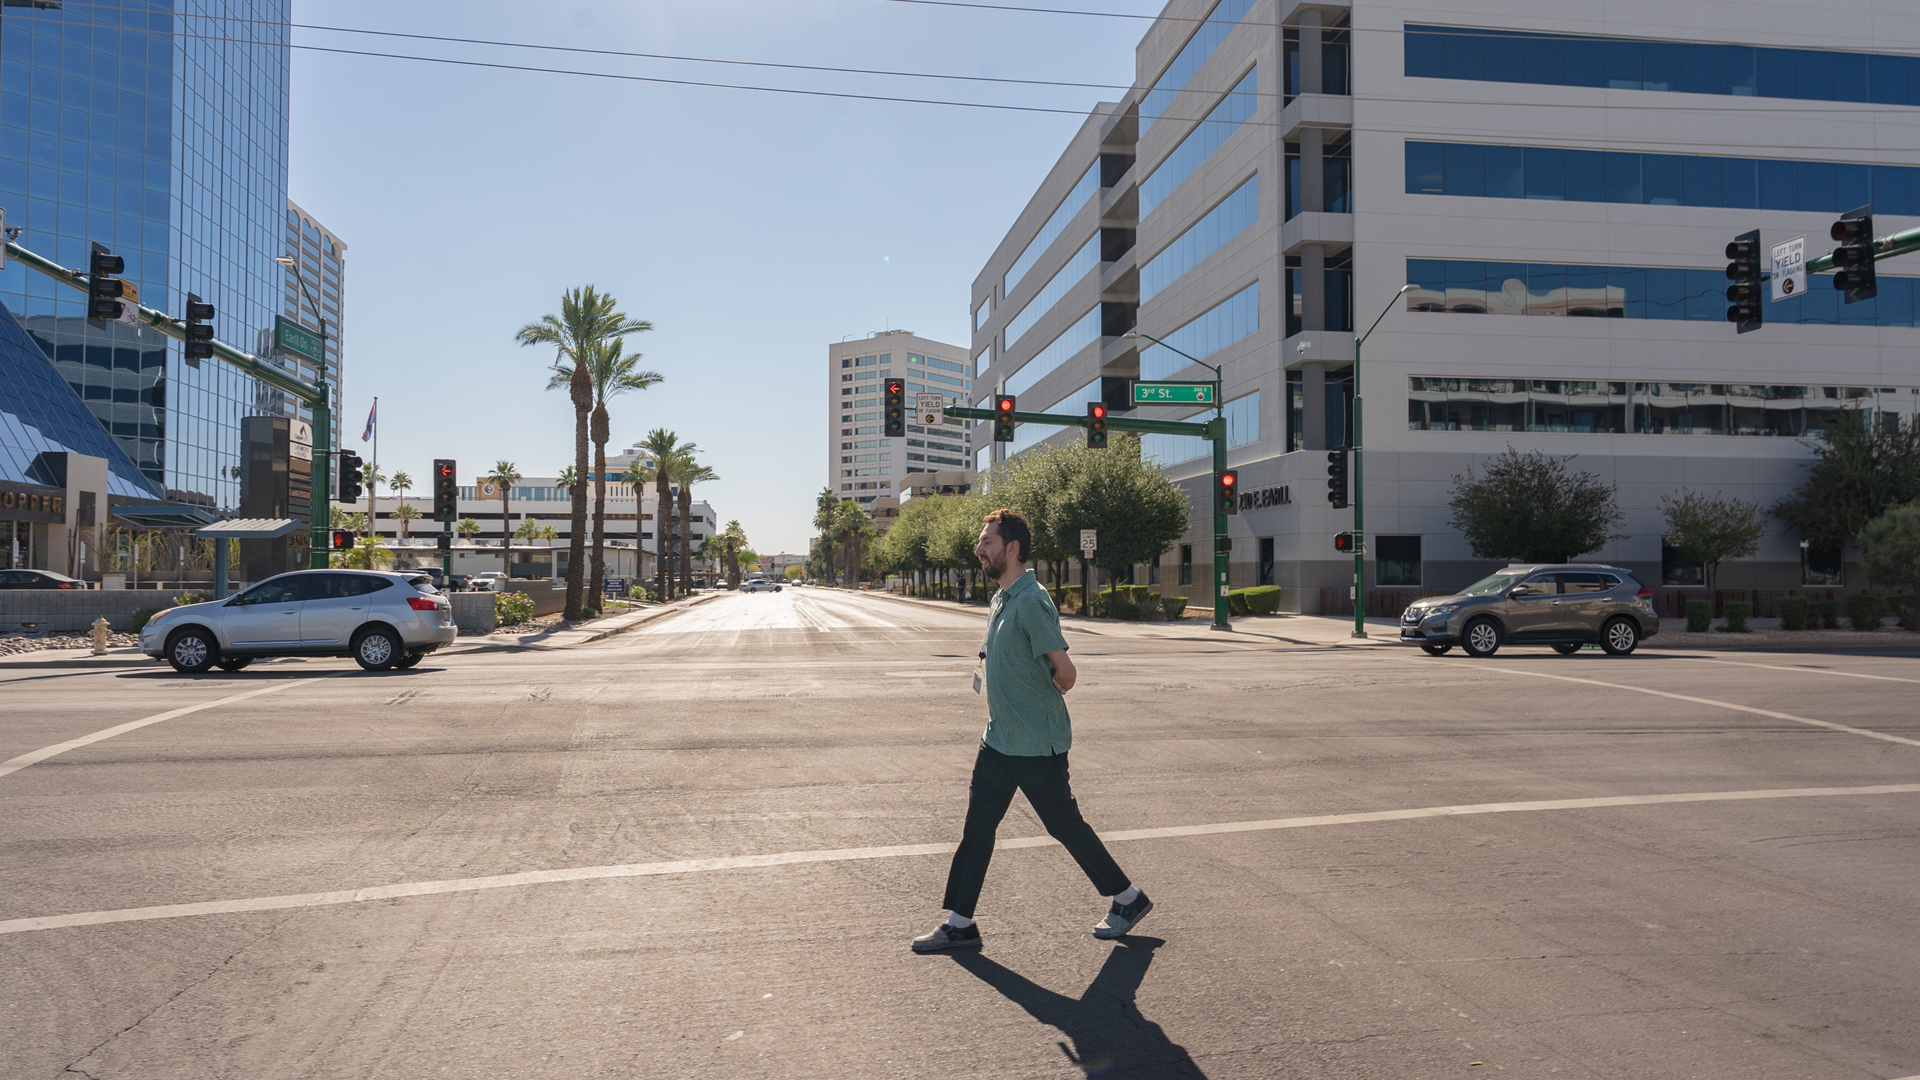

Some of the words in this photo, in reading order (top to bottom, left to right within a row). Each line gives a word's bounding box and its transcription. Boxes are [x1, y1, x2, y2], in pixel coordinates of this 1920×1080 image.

[1773, 247, 1786, 258] LEFT
[1789, 241, 1802, 253] TURN
[1775, 252, 1801, 269] YIELD
[1773, 272, 1779, 280] ON
[1782, 264, 1803, 278] FLASHING
[285, 329, 299, 347] Earll
[1141, 388, 1155, 398] 3rd
[1158, 388, 1173, 398] St.
[1, 491, 61, 513] OPPER
[1262, 485, 1292, 507] EARLL
[1082, 539, 1096, 549] 25
